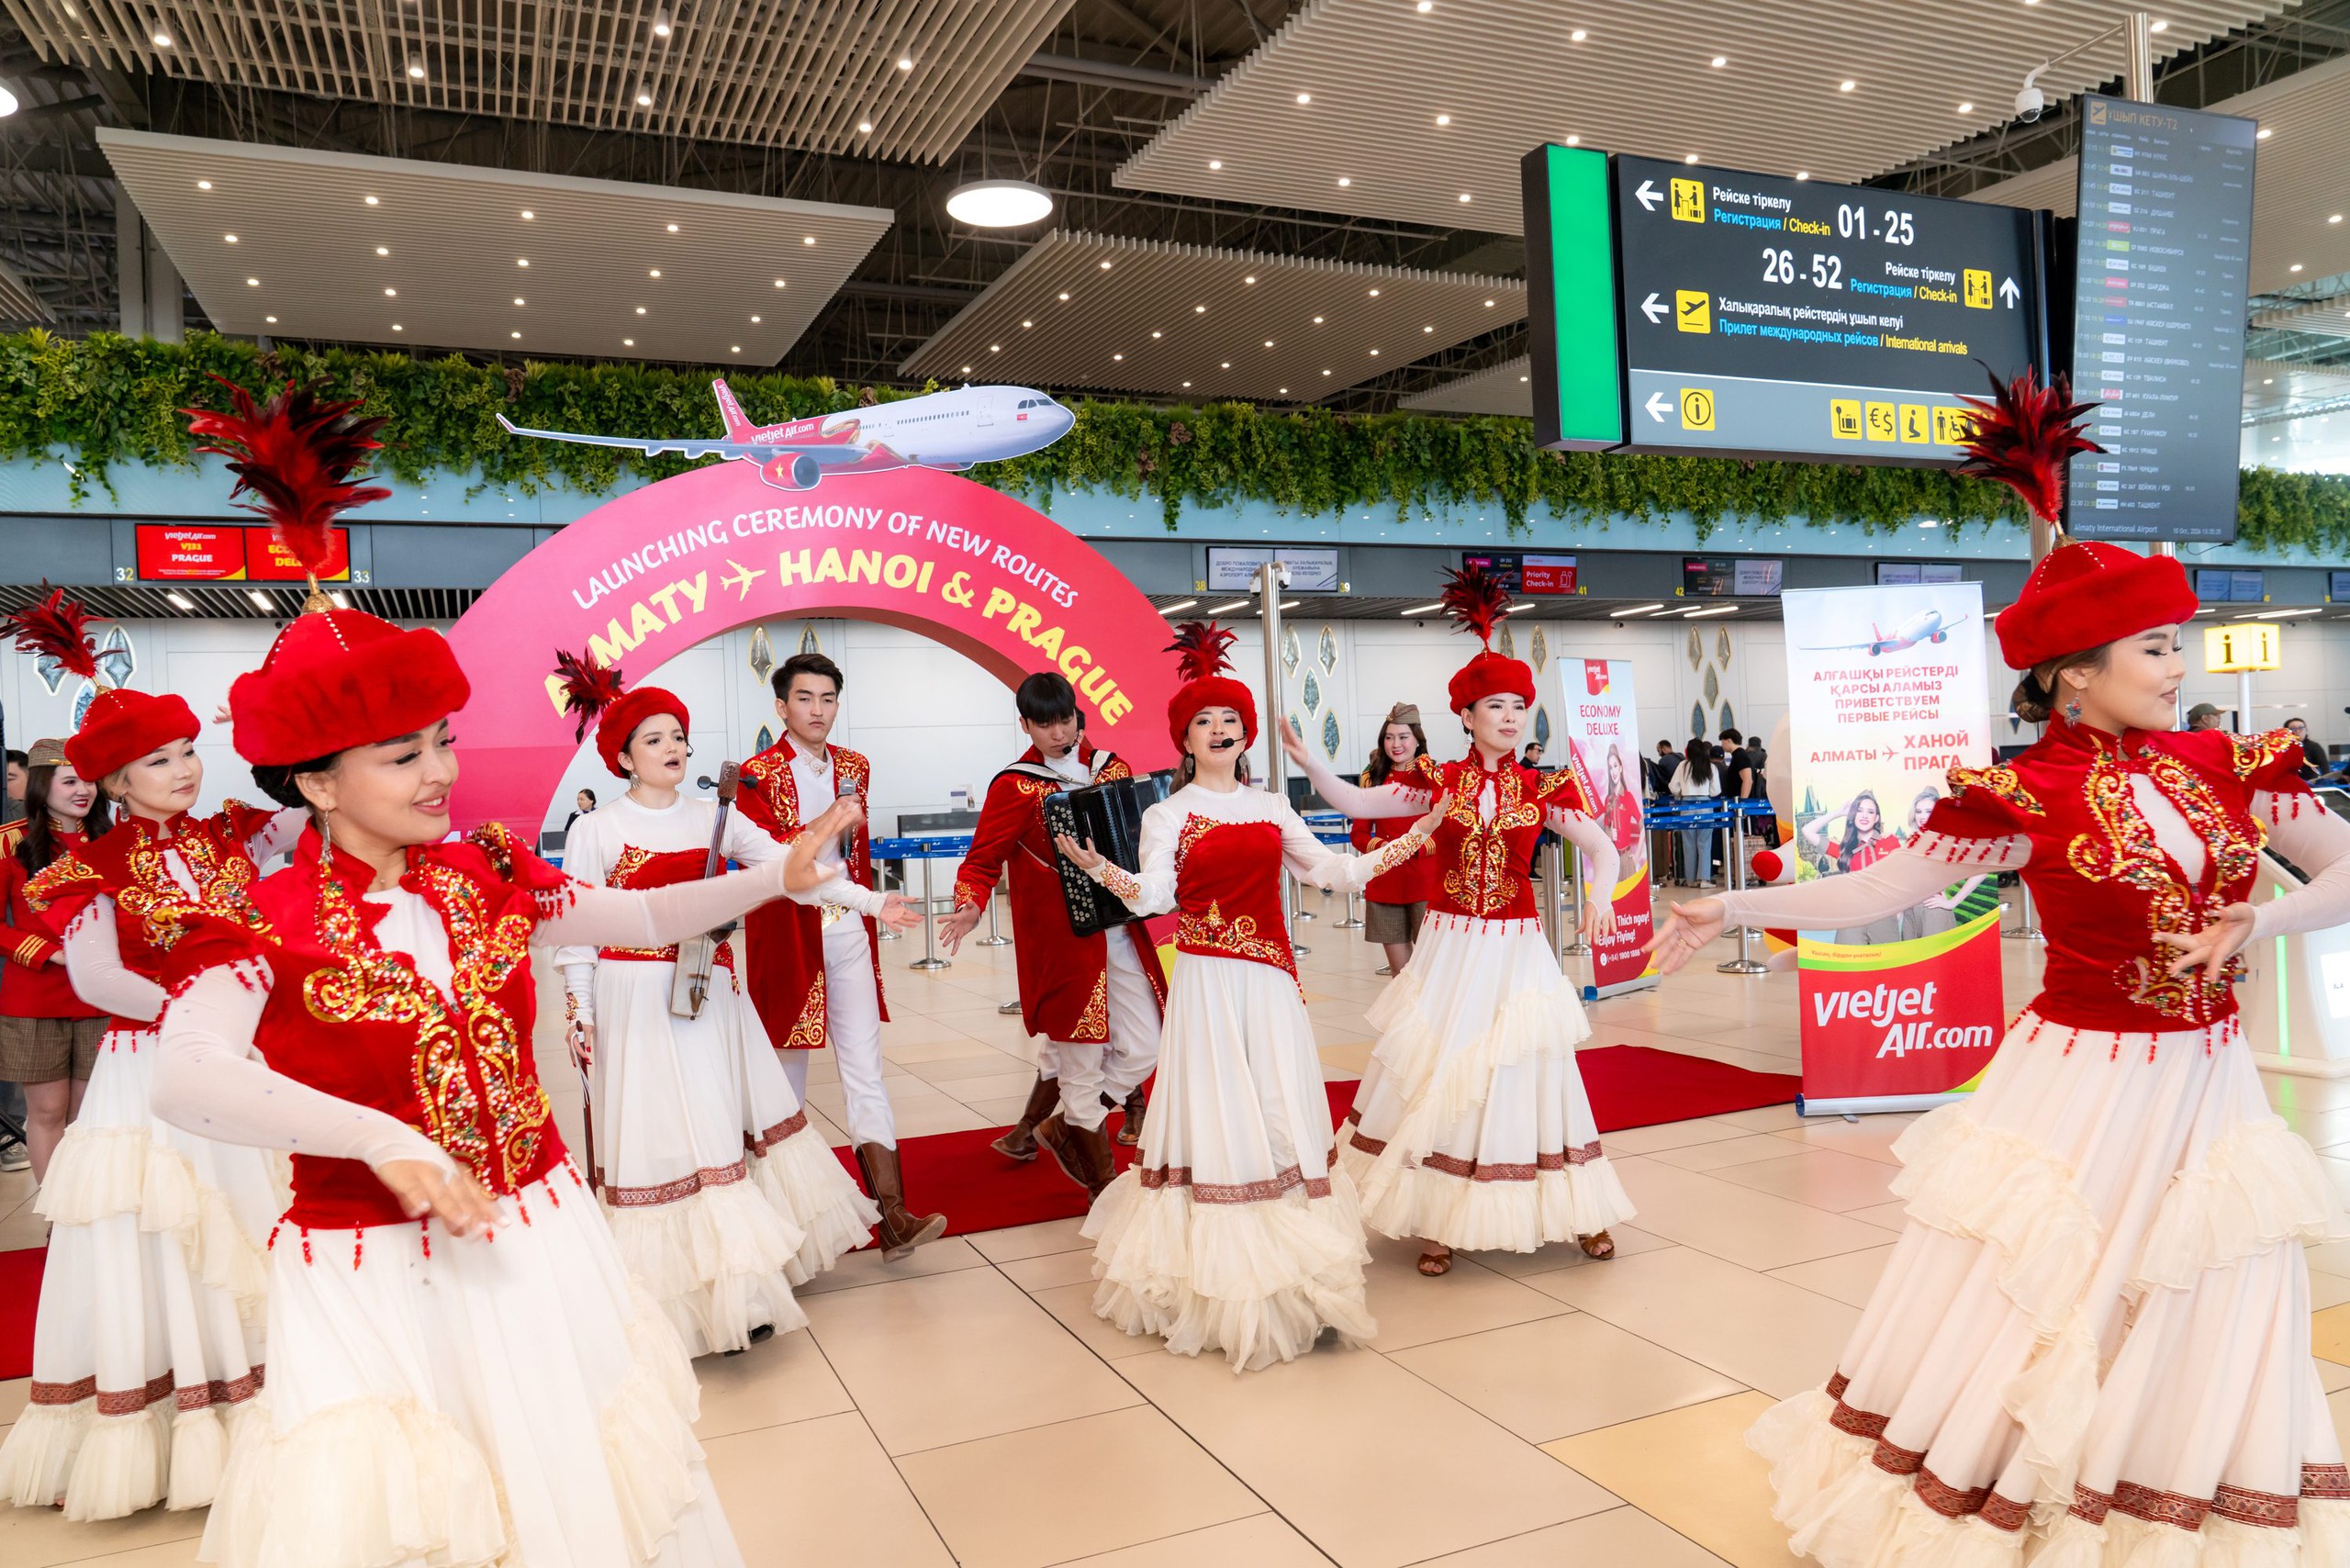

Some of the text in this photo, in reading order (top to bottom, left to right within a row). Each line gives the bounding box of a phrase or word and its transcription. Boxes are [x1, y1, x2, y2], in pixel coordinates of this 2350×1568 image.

[1713, 186, 1792, 213] Рейске тіркелу
[1714, 207, 1781, 230] Регистрация
[1789, 218, 1830, 236] Check-in
[1838, 204, 1865, 240] 01
[1885, 210, 1915, 246] 25
[1762, 248, 1794, 285] 26
[1812, 253, 1843, 290] 52
[1886, 262, 1955, 286] Рейске тіркелу
[1851, 278, 1911, 298] Регистрация
[1919, 286, 1957, 303] Check-in
[1718, 297, 1904, 330] Халықаралық рейстердің ұшып келуі
[1719, 319, 1757, 336] Прилет
[1760, 324, 1841, 343] международных
[1844, 332, 1880, 347] рейсов
[1886, 334, 1937, 353] International
[1937, 340, 1968, 355] arrivals
[2075, 524, 2095, 534] Almaty
[2097, 524, 2135, 533] International
[2137, 525, 2158, 535] Airport
[171, 554, 213, 563] PRAGUE
[275, 556, 303, 567] DEL
[572, 505, 1079, 610] LAUNCHING CEREMONY OF NEW ROUTES
[116, 567, 134, 581] 32
[354, 571, 370, 583] 33
[1526, 571, 1550, 580] Priority
[1195, 580, 1206, 591] 38
[1340, 582, 1351, 593] 39
[1579, 586, 1587, 595] 41
[1674, 588, 1684, 597] 42
[543, 547, 1135, 726] AMATY HANOI & PRAGUE
[1814, 666, 1959, 682] АЛҒАШҚЫ РЕЙСТЕРДІ
[1830, 680, 1942, 696] ҚАРСЫ АЛАМЫЗ
[1835, 695, 1940, 710] ПРИВЕТСТВУЕМ
[1579, 705, 1621, 718] ECONOMY
[1838, 708, 1939, 723] ПЕРВЫЕ РЕЙСЫ
[1586, 722, 1619, 736] DELUXE
[1904, 729, 1970, 749] ХАНОЙ
[1810, 749, 1876, 763] АЛМАТЫ
[1904, 755, 1963, 771] ПРАГА
[1633, 911, 1651, 926] ngay!
[1599, 929, 1636, 947] Enjoy Flying!
[1875, 1021, 1993, 1059] Air.com
